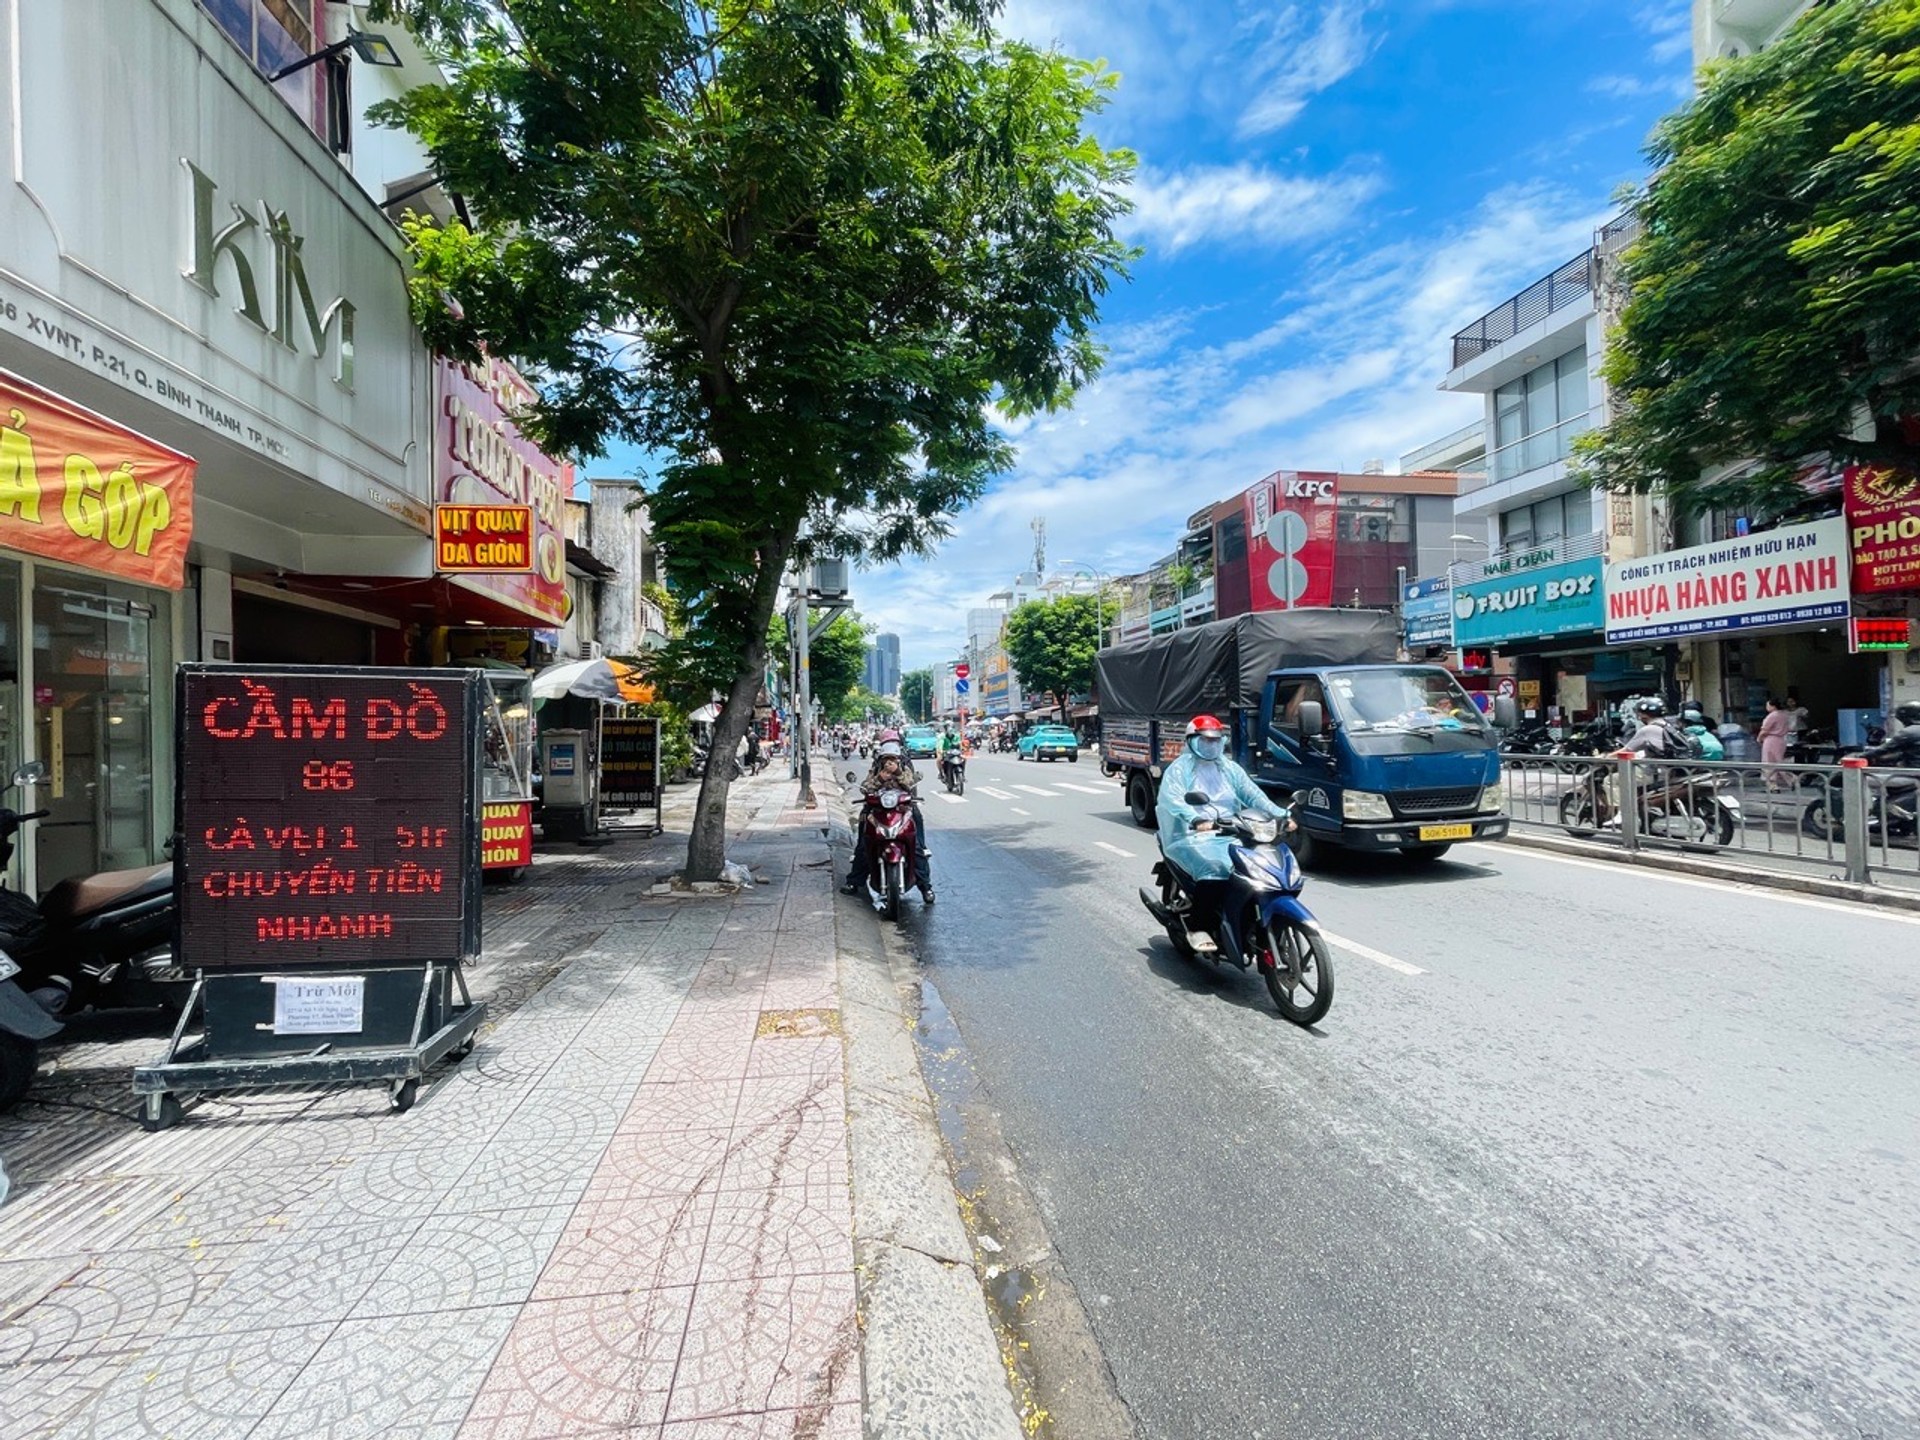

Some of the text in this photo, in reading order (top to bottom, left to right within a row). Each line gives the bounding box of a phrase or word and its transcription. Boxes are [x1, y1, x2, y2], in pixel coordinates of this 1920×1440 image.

[180, 157, 356, 394] KIM
[27, 312, 86, 358] XVNT,
[92, 345, 130, 380] P.21,
[134, 369, 152, 389] Q.
[156, 378, 191, 409] BÌNH
[247, 426, 265, 446] TP.
[62, 453, 171, 557] GÓP
[1285, 479, 1334, 498] KFC
[439, 509, 471, 535] VỊT
[475, 509, 525, 534] QUAY
[442, 537, 524, 565] DA GIÒN
[1621, 532, 1818, 581] CÔNG TY TRÁCH NHIỆM HỮU HẠN
[1477, 585, 1538, 615] FRUIT
[1545, 574, 1595, 601] BOX
[1609, 583, 1670, 621] NHỰA
[1676, 570, 1748, 610] HÀNG
[1755, 556, 1838, 600] XANH
[202, 679, 448, 741] CẦM ĐỒ
[302, 759, 355, 791] 86
[257, 913, 393, 942] NHANH
